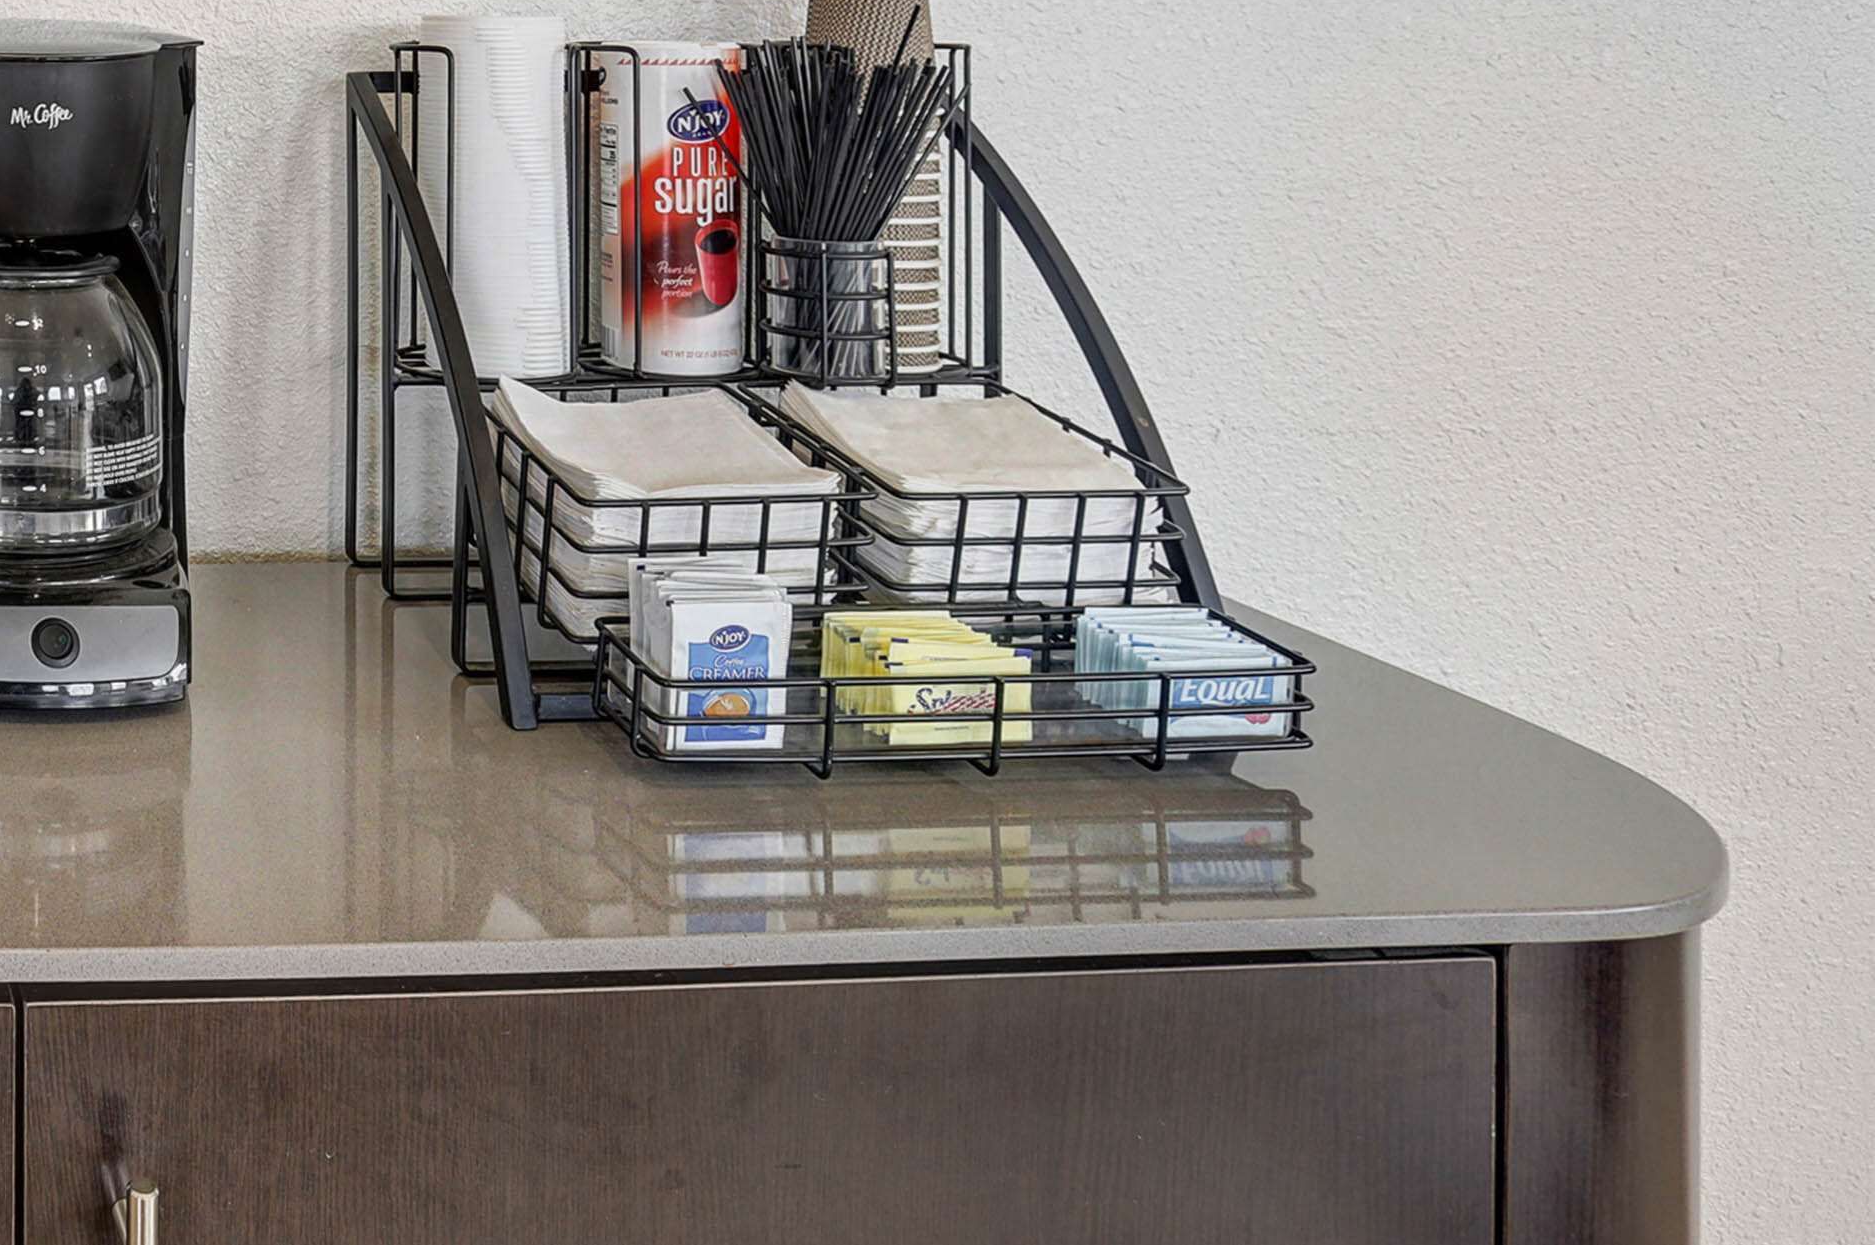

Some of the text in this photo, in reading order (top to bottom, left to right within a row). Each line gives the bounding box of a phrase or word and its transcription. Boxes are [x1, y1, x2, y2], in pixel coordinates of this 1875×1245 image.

[33, 103, 74, 130] Coffee
[673, 147, 728, 177] PURE
[654, 177, 738, 227] sugar
[661, 275, 693, 289] perfect
[35, 364, 47, 374] 10
[689, 666, 766, 680] CREAMER
